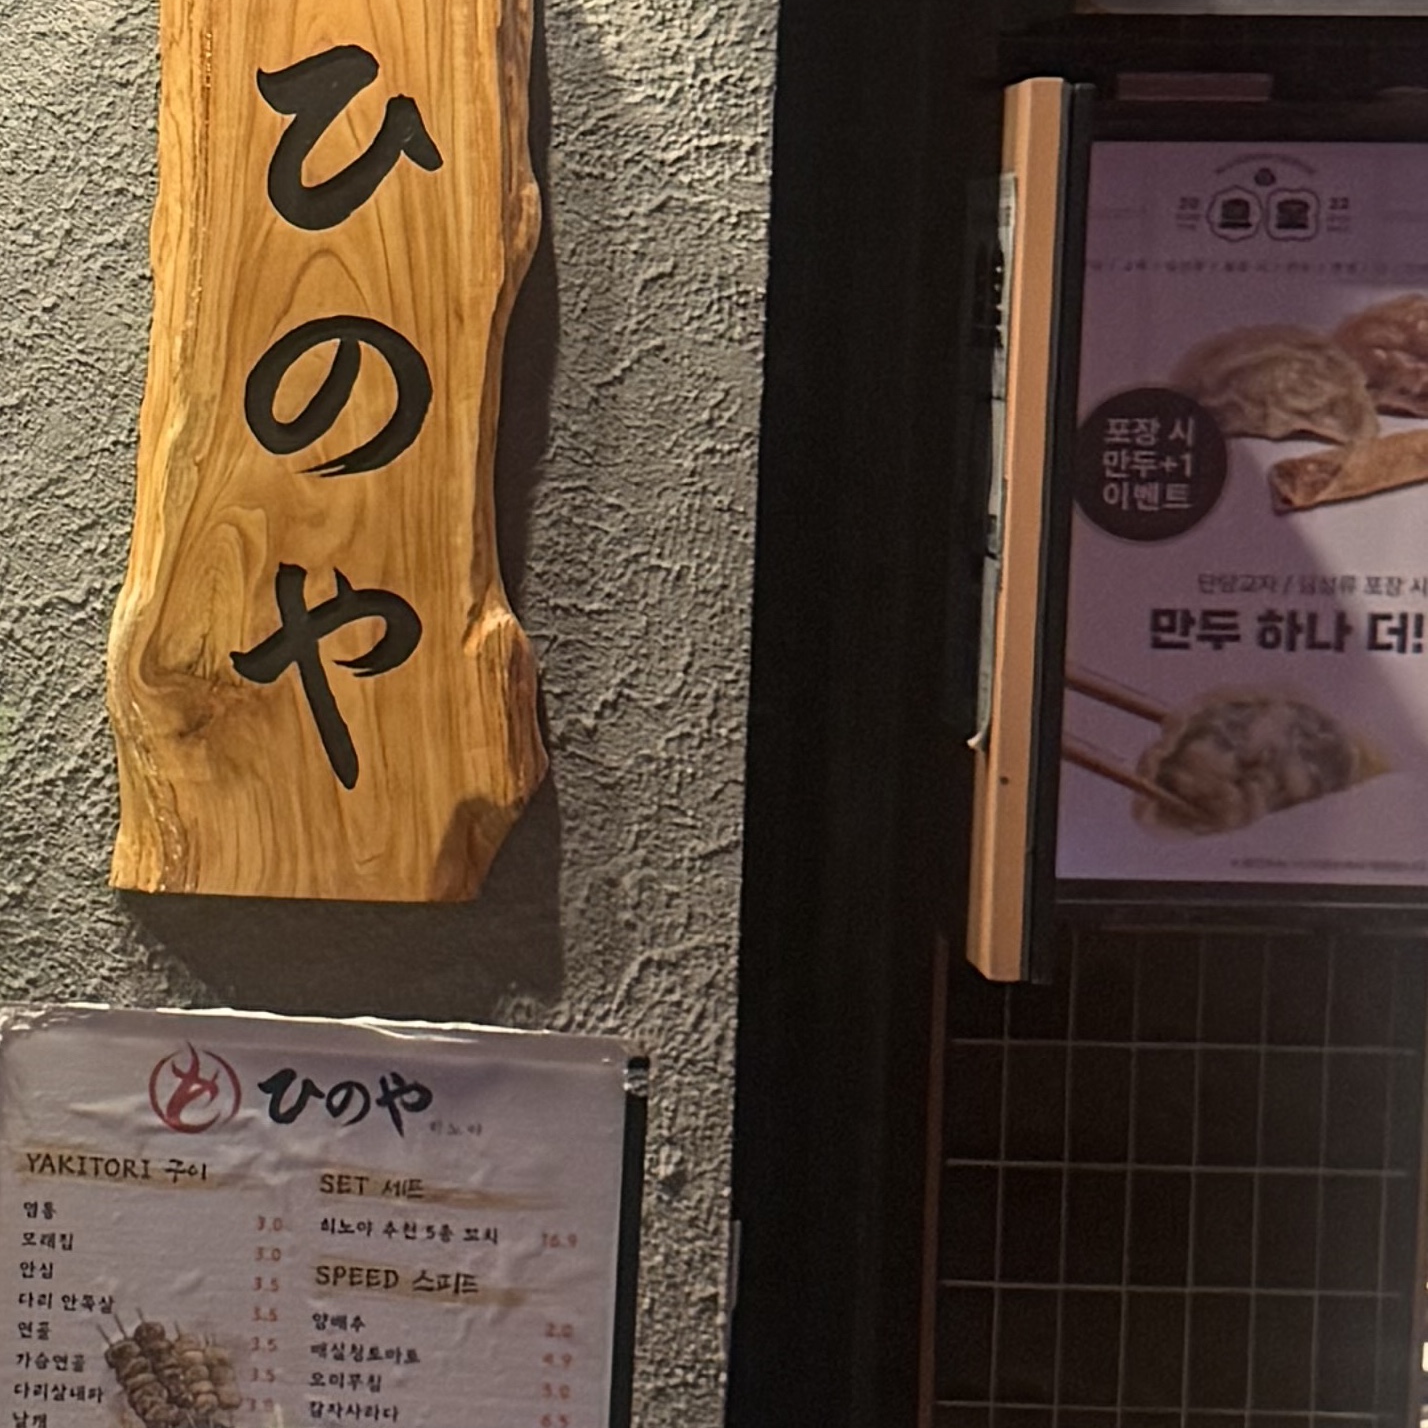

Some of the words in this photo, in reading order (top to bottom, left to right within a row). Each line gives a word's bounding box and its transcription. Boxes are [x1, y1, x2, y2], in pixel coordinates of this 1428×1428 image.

[229, 45, 443, 790] ひのや
[1104, 415, 1161, 446] 포장
[1168, 416, 1195, 447] 시
[1103, 449, 1192, 478] 만두+1
[1103, 481, 1193, 511] 이벤트
[1150, 607, 1242, 651] 만두
[1256, 608, 1354, 653] 하나
[1366, 611, 1425, 654] 더!
[257, 1067, 434, 1139] ひのや
[26, 1153, 151, 1180] YAKITORI
[165, 1158, 208, 1183] 구이
[319, 1173, 369, 1196] SET
[381, 1178, 424, 1199] 세트
[21, 1232, 74, 1251] 모래집
[320, 1218, 373, 1236] 히노야
[19, 1261, 54, 1279] 안심
[314, 1265, 399, 1290] SPEED
[412, 1269, 479, 1295] 스피드
[18, 1292, 53, 1310] 다리
